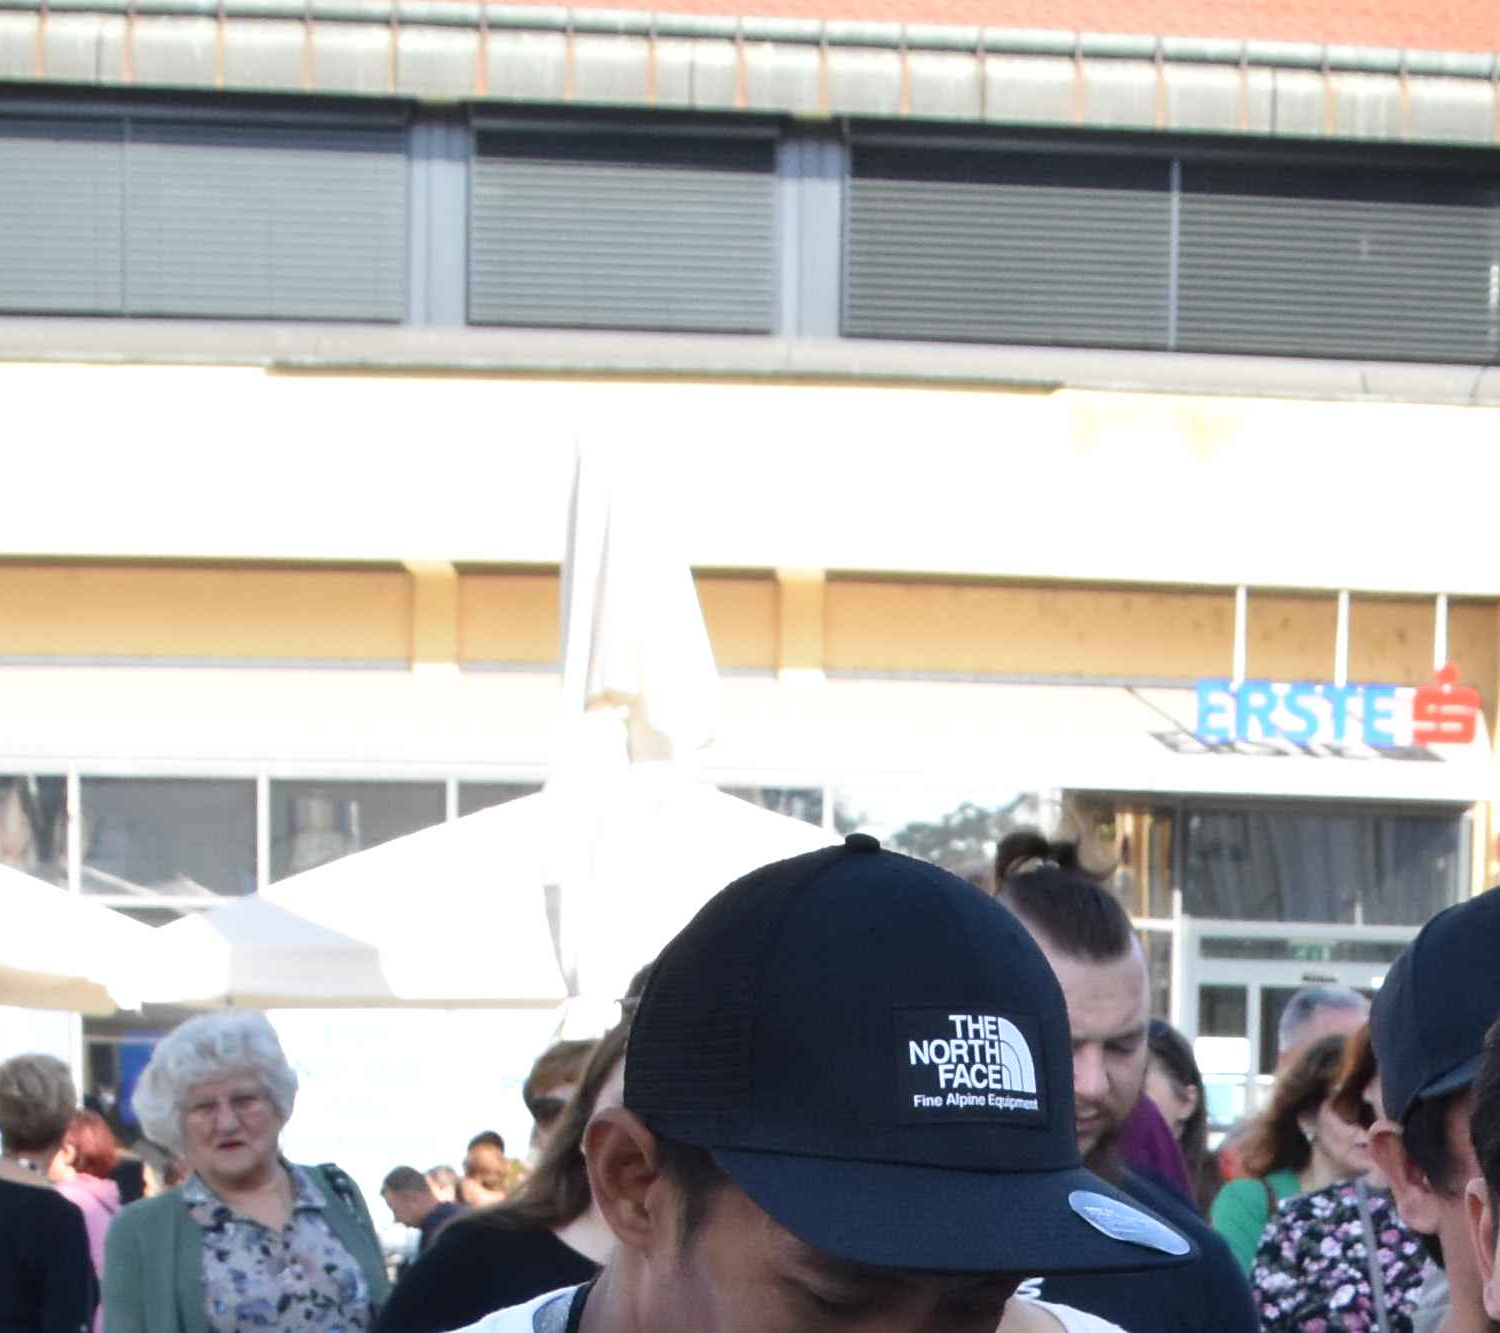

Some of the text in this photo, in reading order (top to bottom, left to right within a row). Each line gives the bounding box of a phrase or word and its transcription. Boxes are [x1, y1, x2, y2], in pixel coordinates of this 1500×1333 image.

[1196, 678, 1398, 748] ERSTE
[948, 1014, 999, 1040] THE
[908, 1039, 1001, 1066] NORTH
[937, 1063, 1002, 1090] FACE
[913, 1092, 1039, 1111] Fine Alpine Equipment
